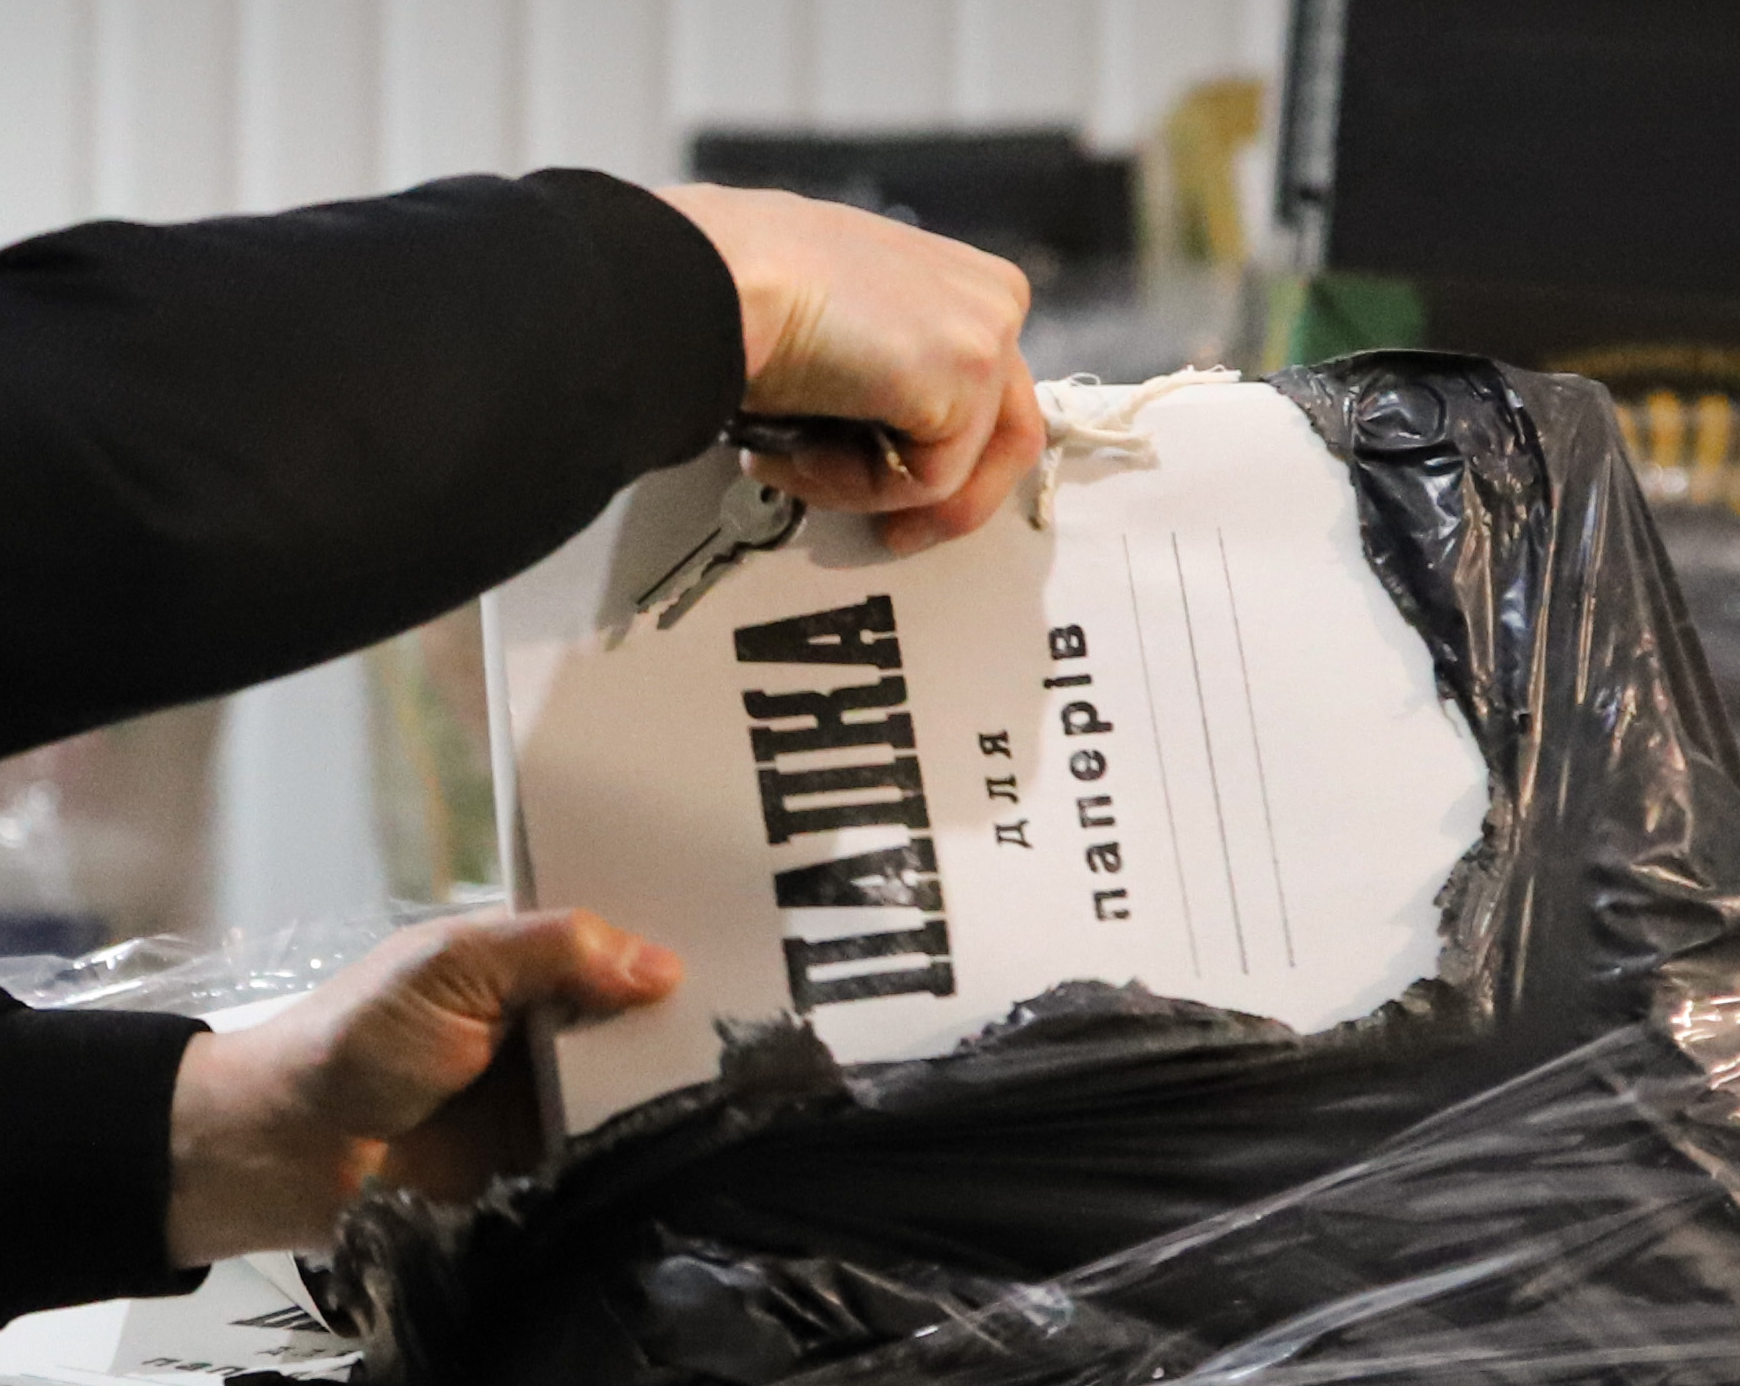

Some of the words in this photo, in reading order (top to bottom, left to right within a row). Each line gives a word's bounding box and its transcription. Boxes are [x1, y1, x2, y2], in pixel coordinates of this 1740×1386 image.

[734, 594, 956, 1013] ПАПКА
[976, 728, 1034, 850] для
[1041, 623, 1132, 922] паперів
